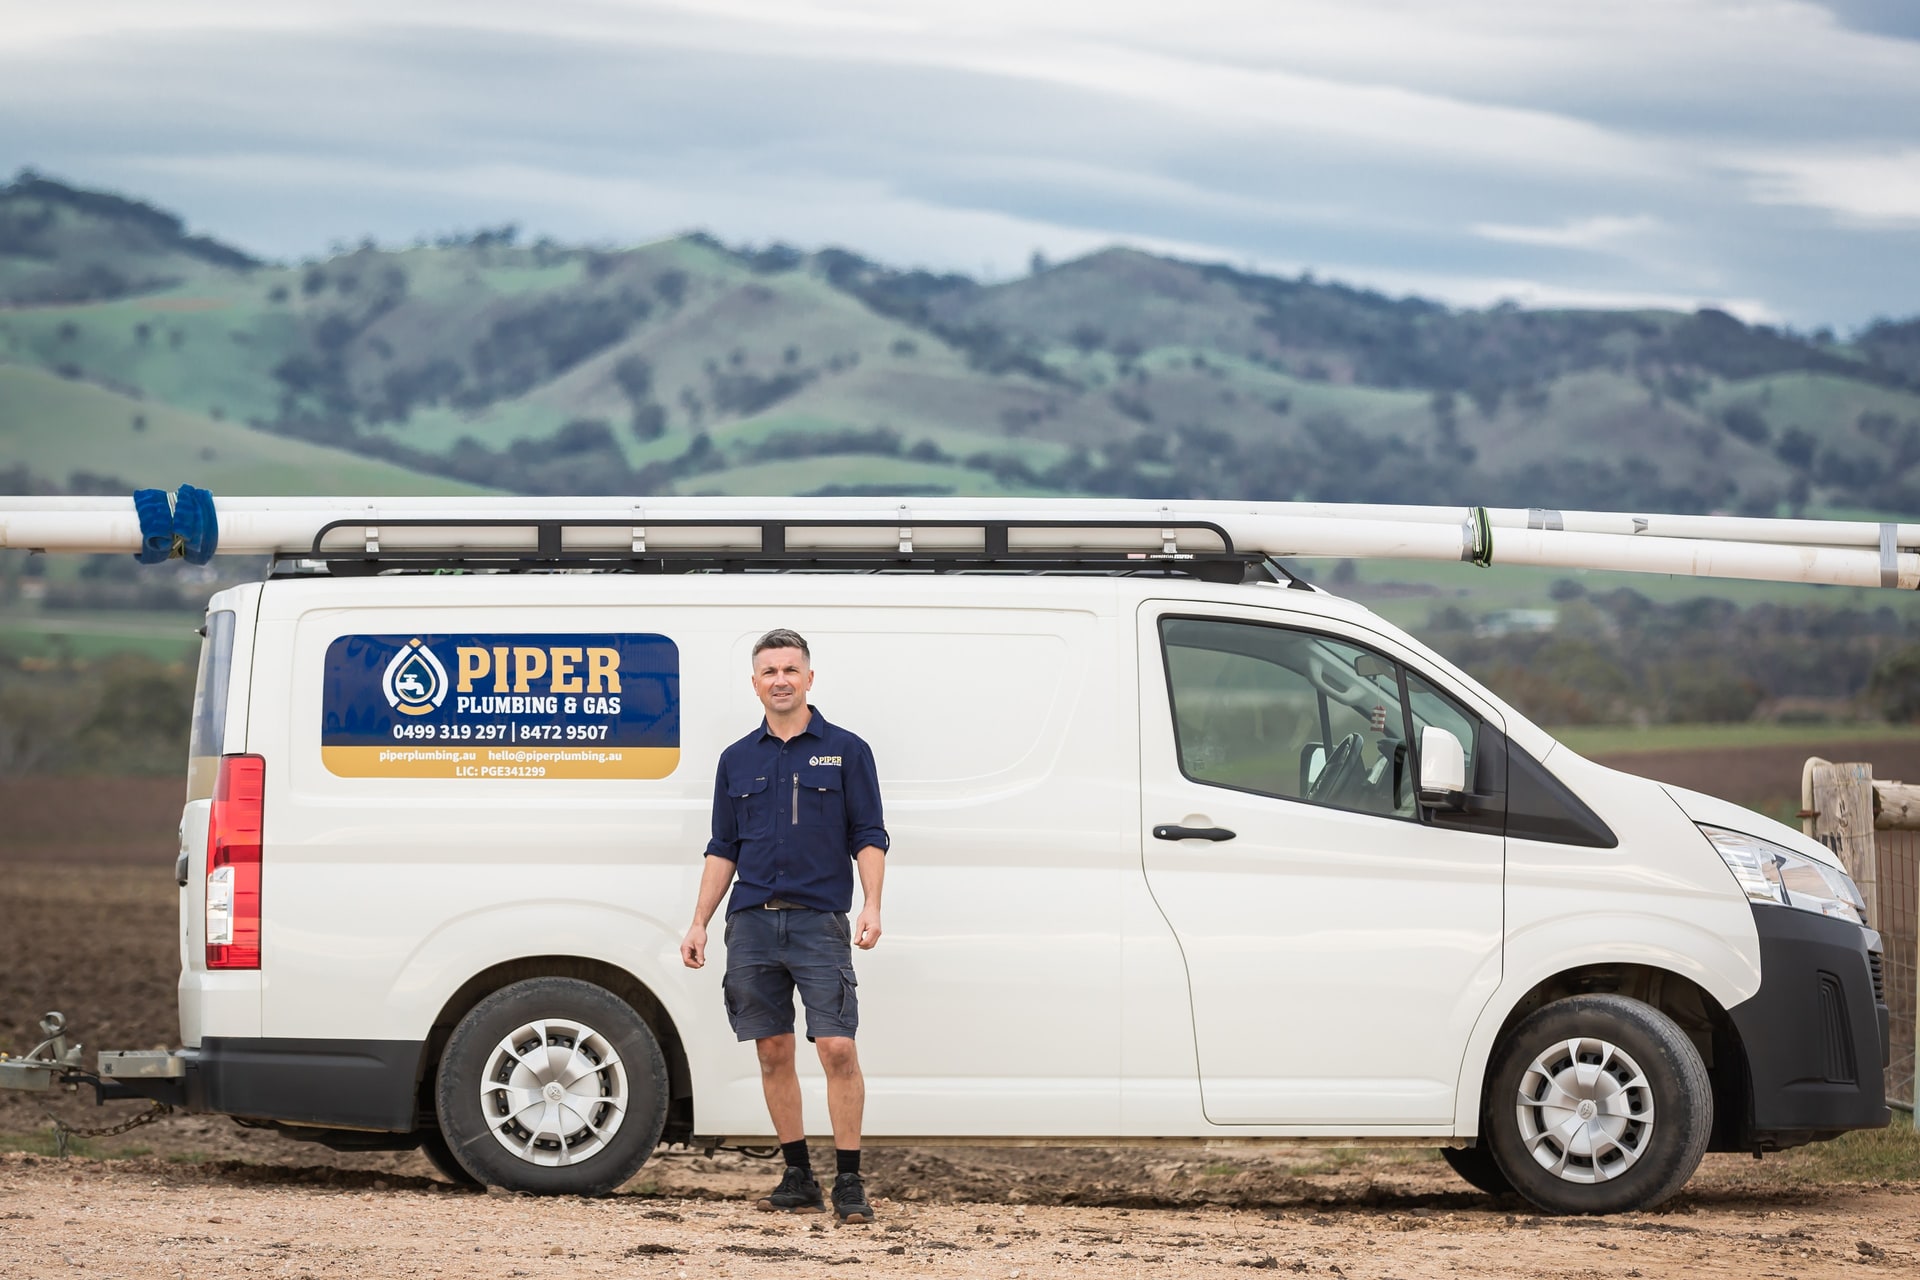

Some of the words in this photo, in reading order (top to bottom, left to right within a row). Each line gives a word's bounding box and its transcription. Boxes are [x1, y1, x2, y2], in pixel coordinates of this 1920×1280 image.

[456, 646, 622, 693] PIPER
[457, 696, 558, 714] PLUMBING
[564, 697, 578, 714] &
[583, 697, 621, 715] GAS
[393, 724, 436, 740] 0499
[439, 724, 472, 740] 319
[475, 725, 507, 740] 297
[520, 725, 562, 740] 8472
[566, 725, 608, 740] 9507
[379, 750, 476, 763] piperplumbing.au
[488, 750, 623, 763] hello@piperplumbing.au
[819, 756, 842, 764] PIPER
[455, 766, 479, 777] LIC:
[481, 766, 546, 777] PGE341299
